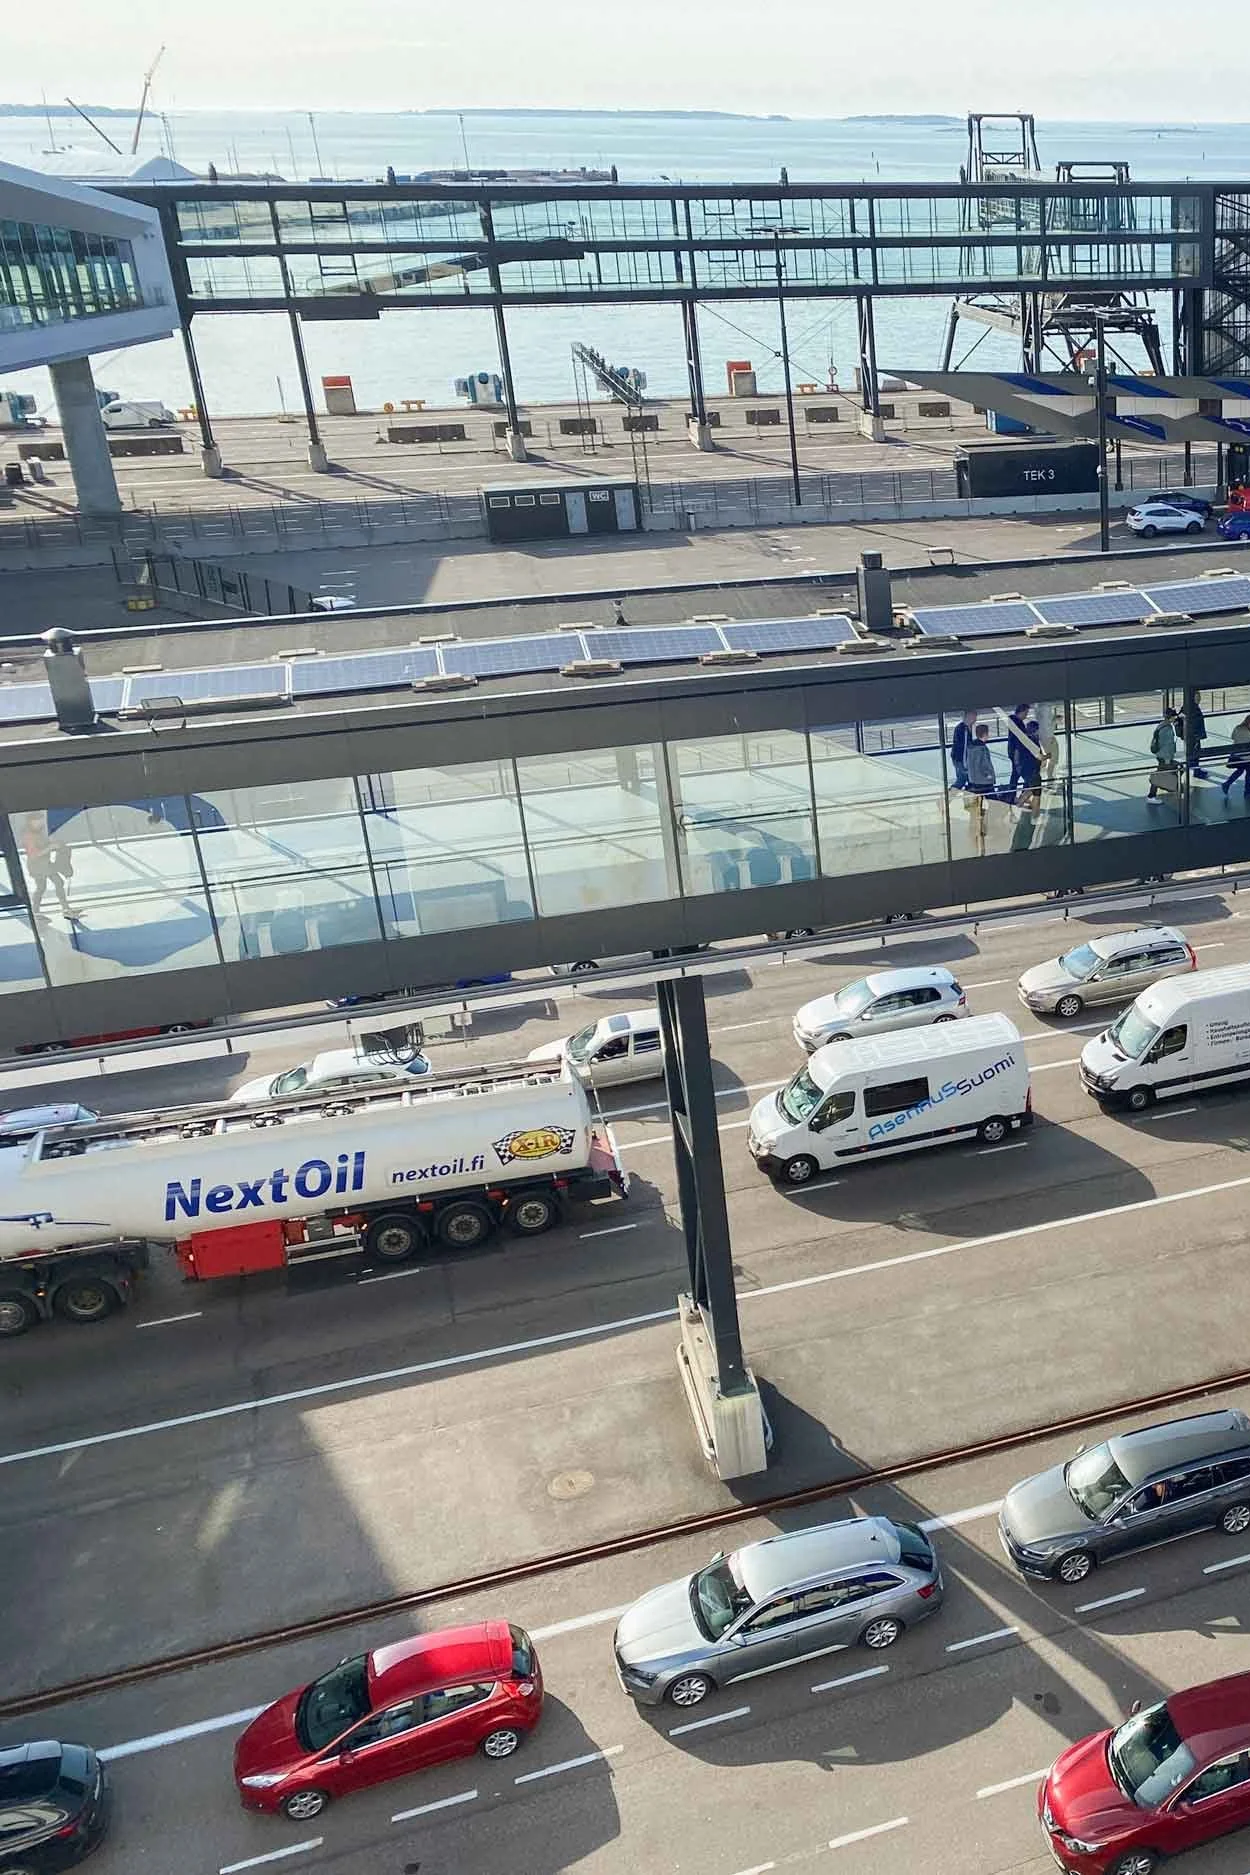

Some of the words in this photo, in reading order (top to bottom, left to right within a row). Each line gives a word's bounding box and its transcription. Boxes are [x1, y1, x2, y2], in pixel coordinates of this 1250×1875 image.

[1023, 470, 1046, 481] TEK
[1048, 468, 1056, 480] 3
[591, 491, 607, 501] WC
[391, 1155, 485, 1184] nextoil.fi
[164, 1150, 366, 1221] NextOil
